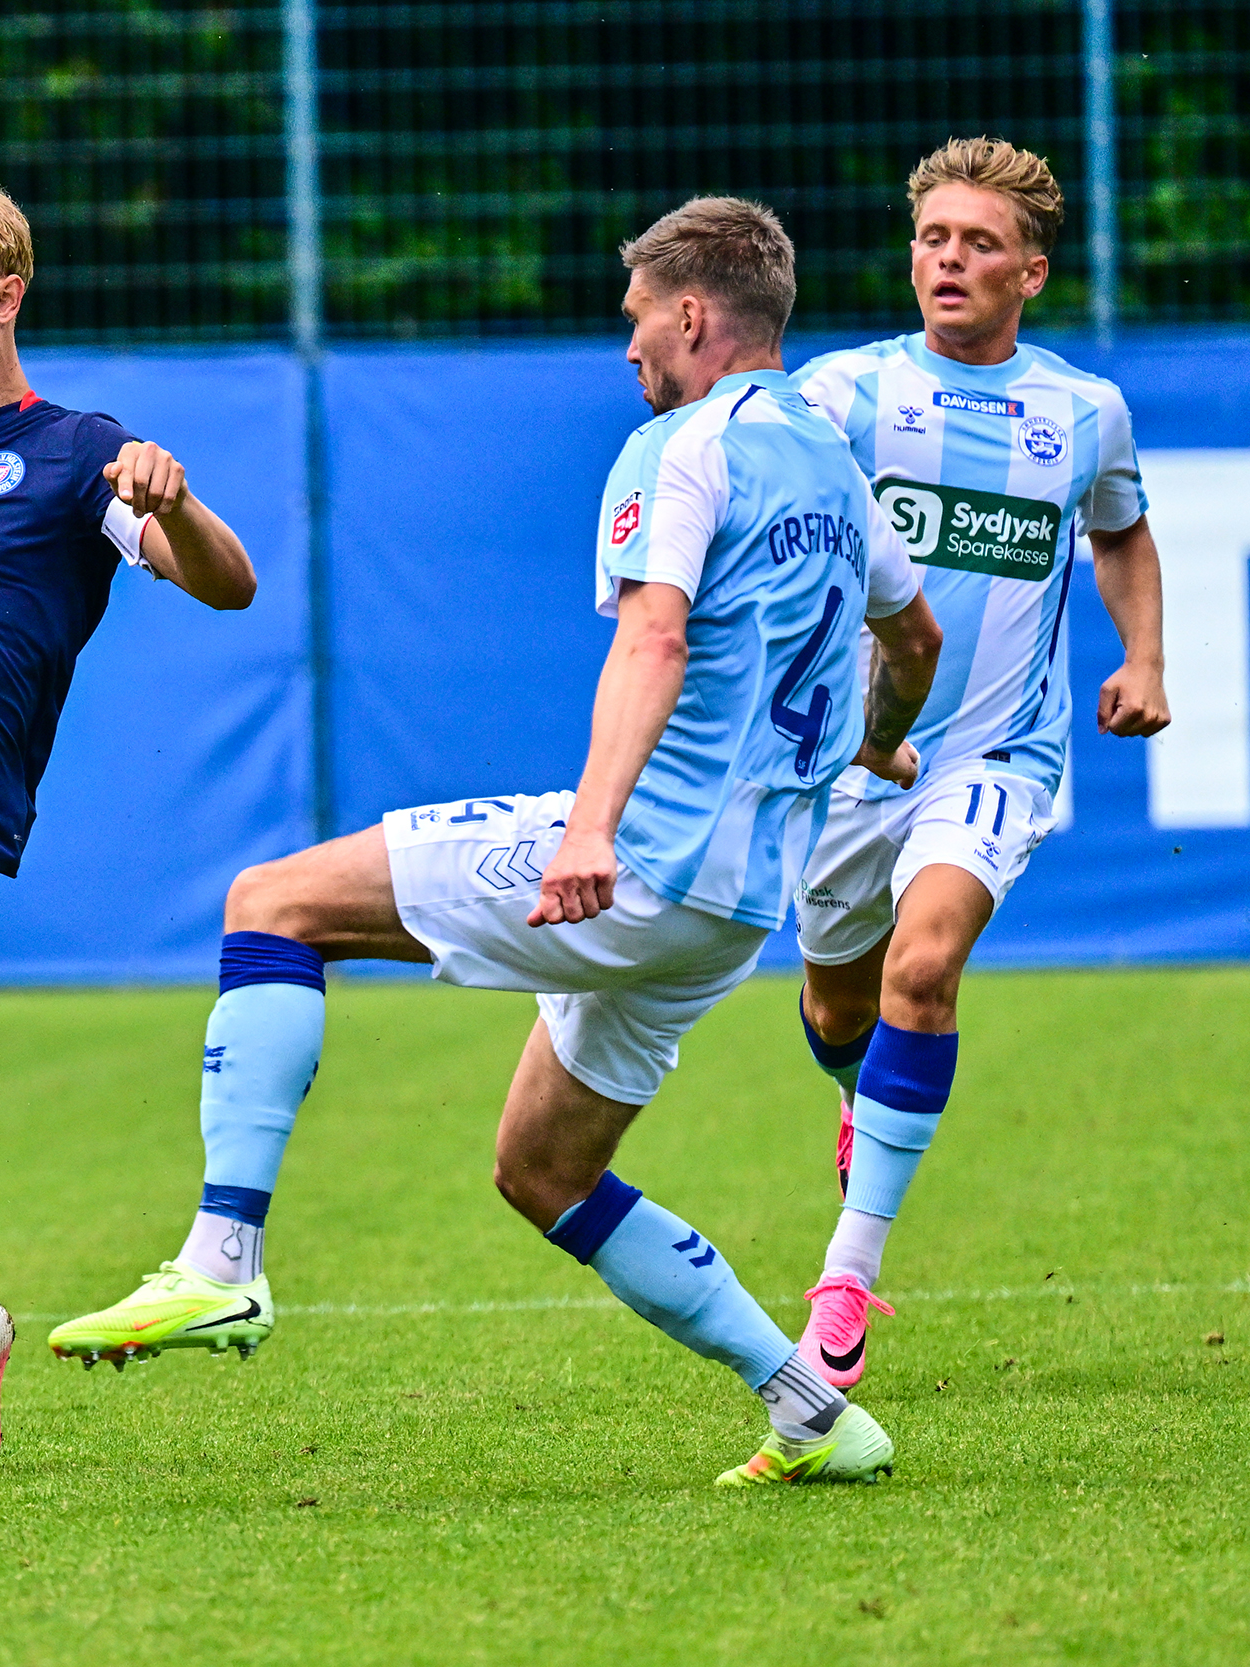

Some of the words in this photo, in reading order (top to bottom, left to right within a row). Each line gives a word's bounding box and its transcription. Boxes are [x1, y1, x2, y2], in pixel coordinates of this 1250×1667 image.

[940, 394, 1006, 415] DAVIDSEN
[893, 422, 926, 435] hummel
[950, 502, 1054, 543] Sydjysk
[947, 533, 1049, 566] Sparekasse
[770, 585, 844, 784] 4
[964, 783, 1009, 841] 11
